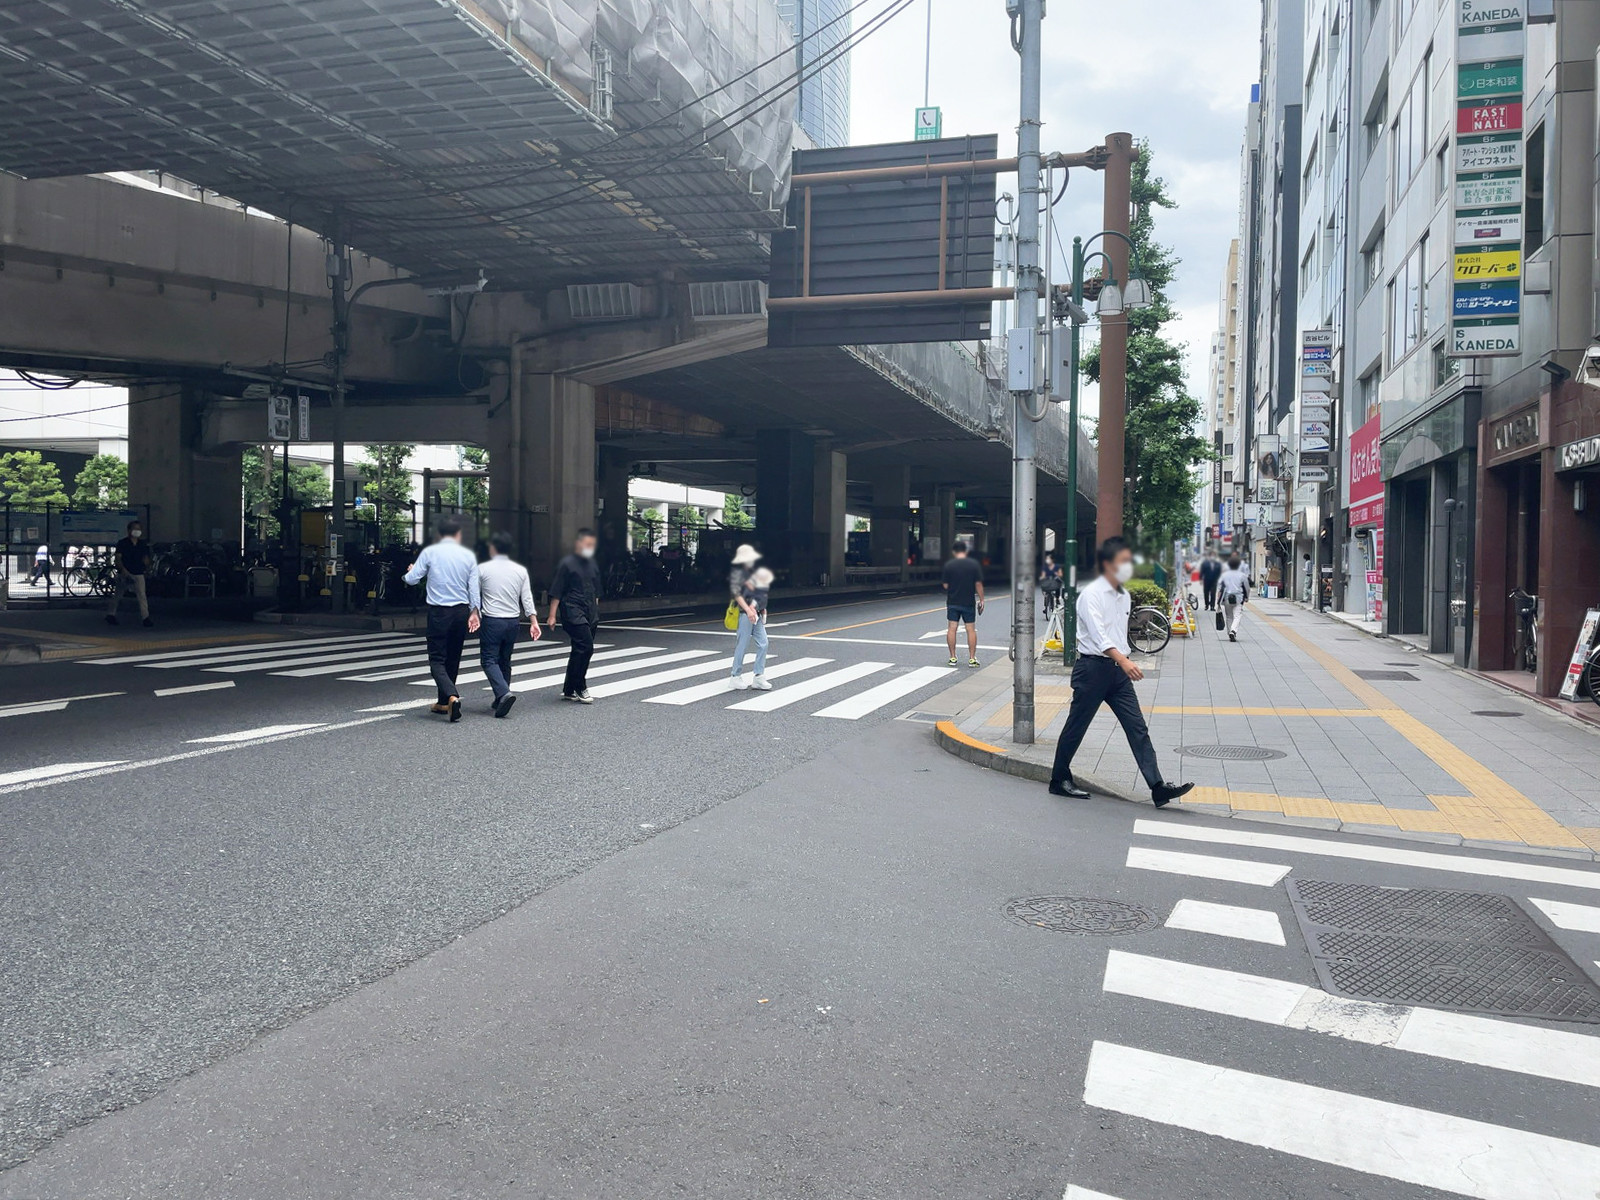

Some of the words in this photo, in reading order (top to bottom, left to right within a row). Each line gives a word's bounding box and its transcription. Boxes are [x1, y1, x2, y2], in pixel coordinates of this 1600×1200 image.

[1462, 8, 1520, 22] KANEDA
[1476, 76, 1518, 88] 日本和装
[1474, 106, 1506, 118] FAST
[1474, 119, 1506, 130] NAIL
[1462, 156, 1516, 166] アイエフネット
[1457, 264, 1506, 275] クローバー
[1456, 339, 1515, 351] KANEDA
